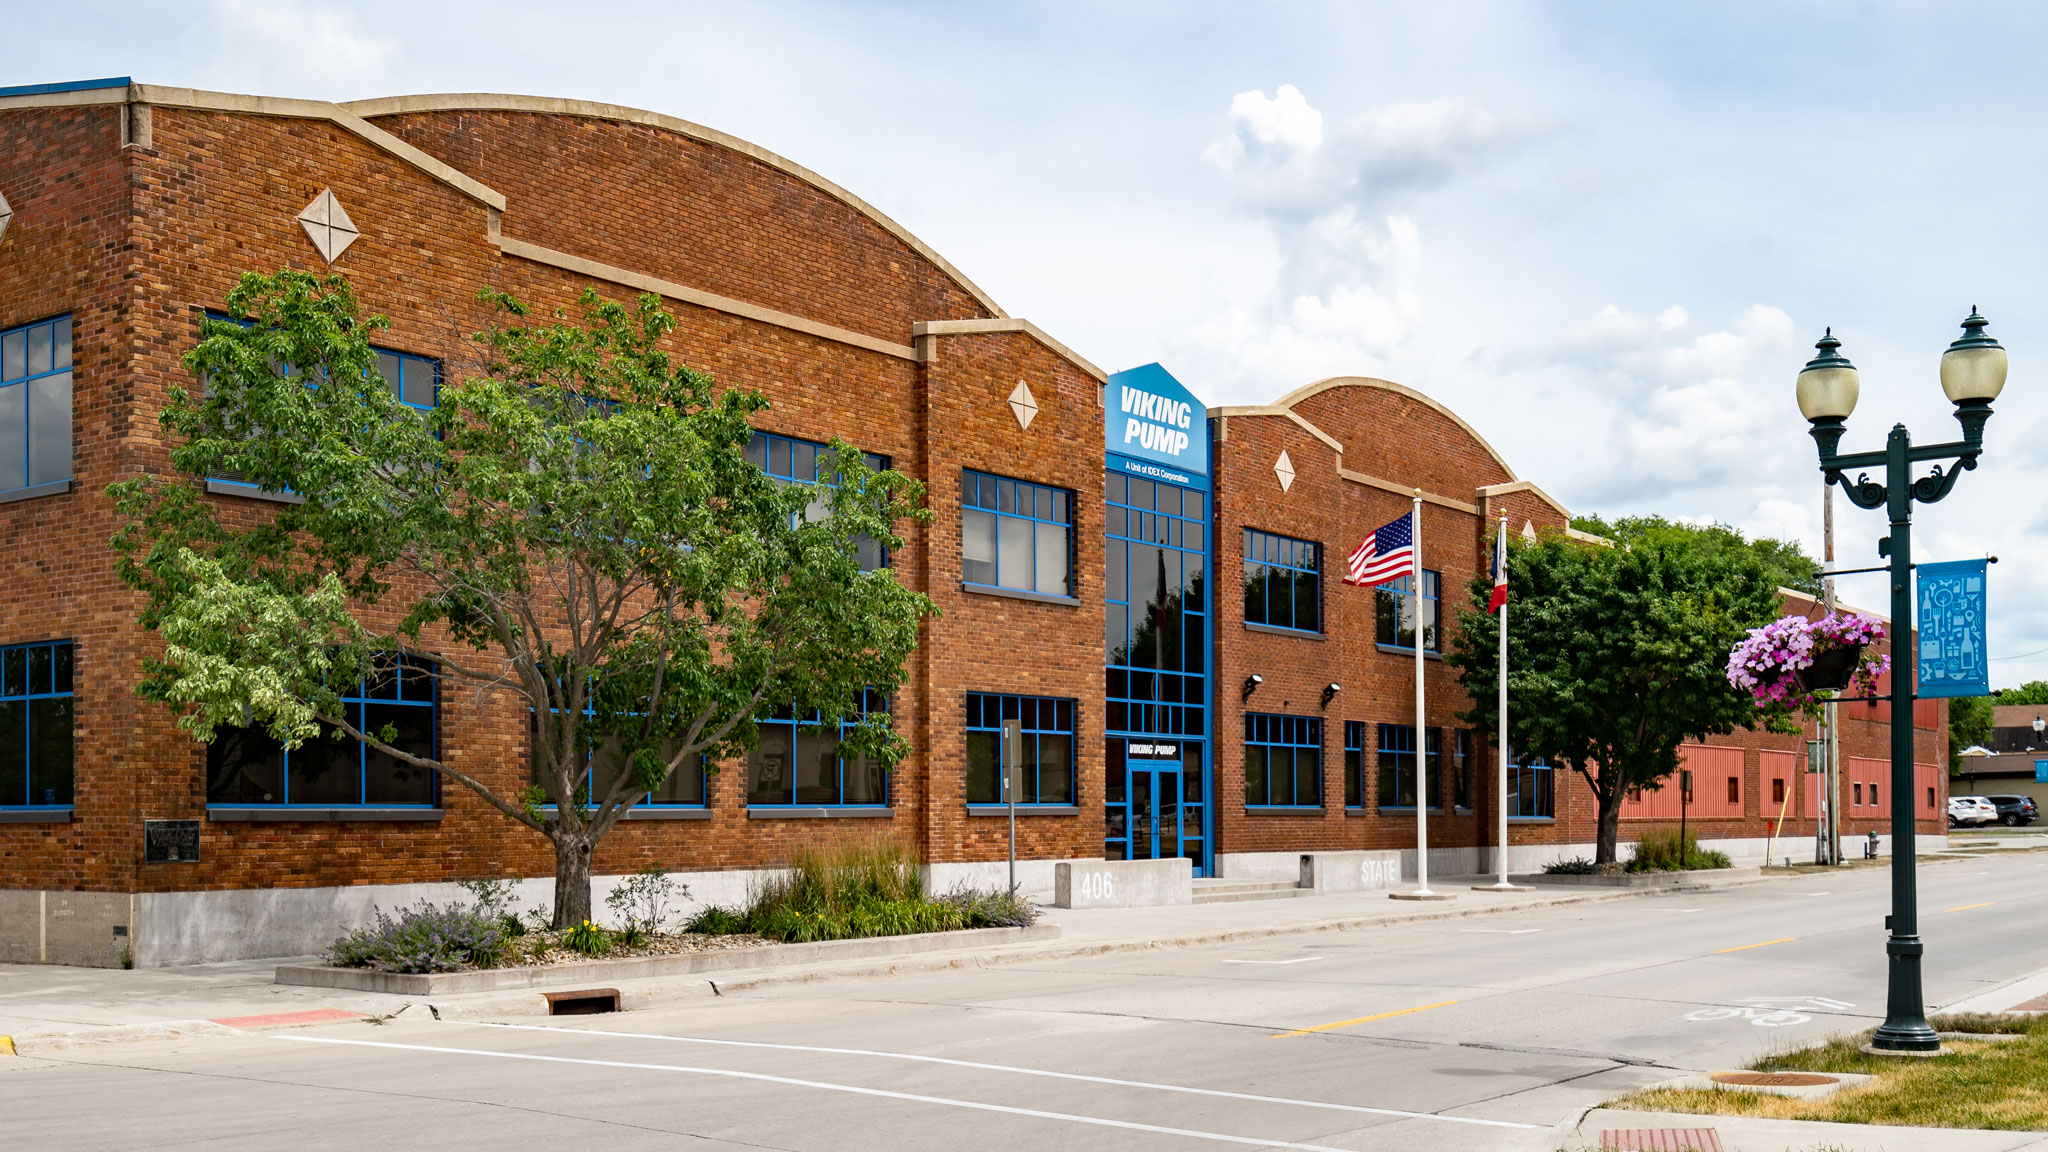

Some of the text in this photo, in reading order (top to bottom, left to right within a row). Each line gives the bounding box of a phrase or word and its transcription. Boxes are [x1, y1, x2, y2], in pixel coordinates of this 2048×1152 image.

[1121, 385, 1191, 429] VIKING
[1124, 418, 1189, 456] PUMP
[1126, 461, 1189, 483] A Unit of IDEX Corporation
[1129, 743, 1176, 756] VIKING PUMP
[1361, 859, 1396, 882] STATE
[1081, 871, 1113, 899] 406
